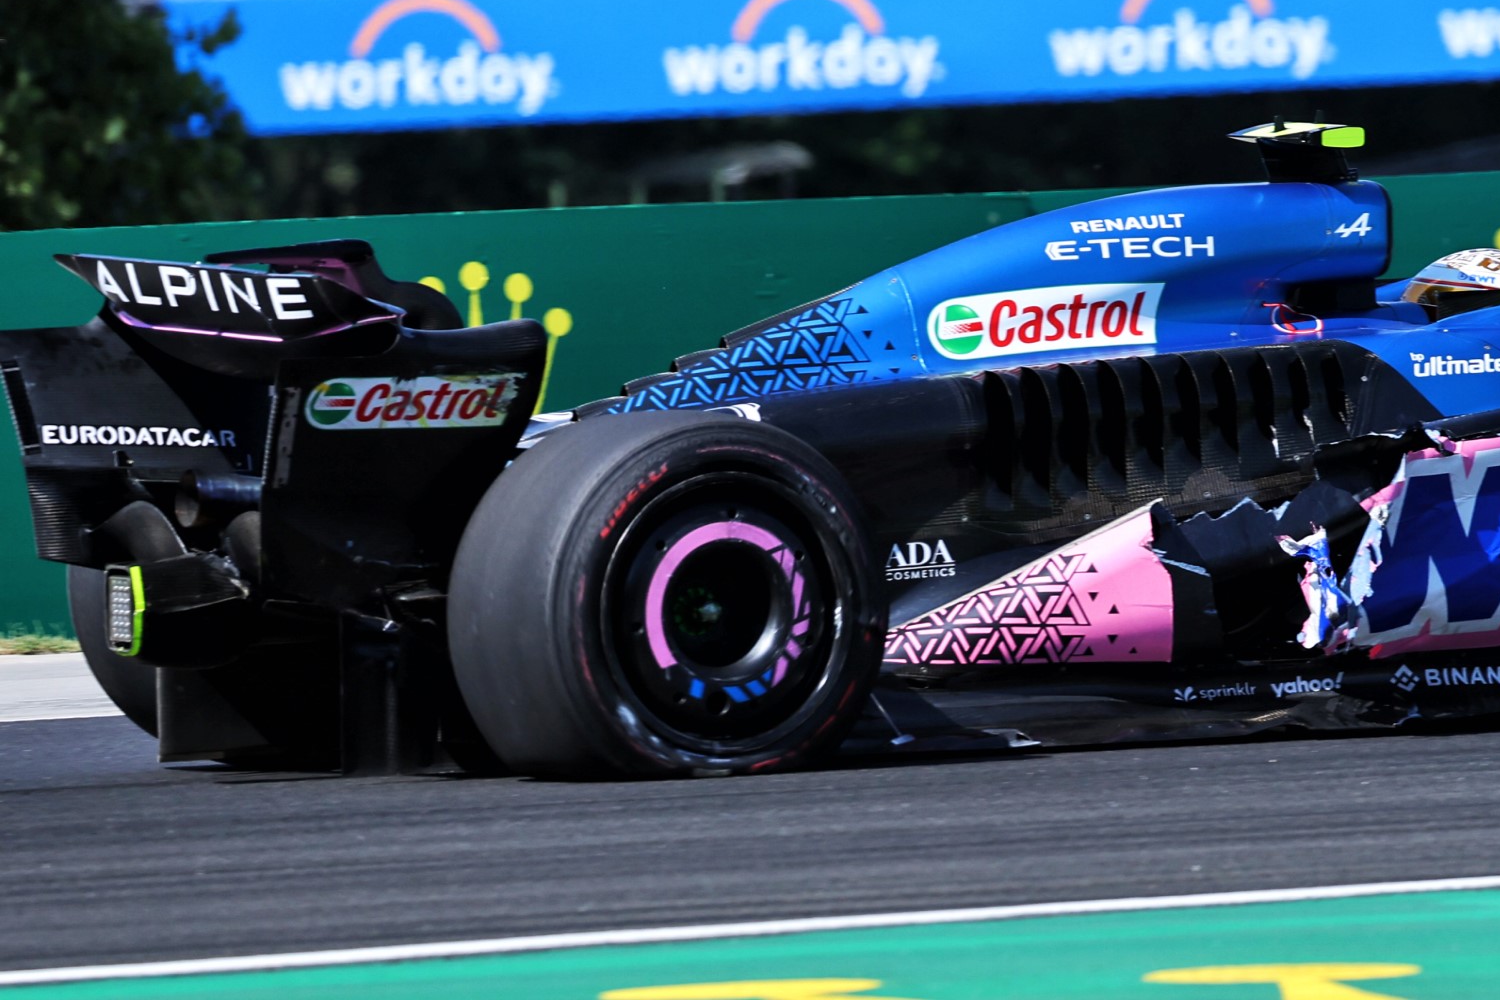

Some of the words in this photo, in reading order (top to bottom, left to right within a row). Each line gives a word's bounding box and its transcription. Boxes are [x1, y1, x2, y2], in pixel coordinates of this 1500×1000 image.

[1048, 4, 1330, 79] workday
[663, 22, 940, 98] workday
[279, 41, 554, 115] workday
[1070, 213, 1185, 234] RENAULT
[1044, 235, 1215, 261] E-TECH
[96, 260, 314, 320] ALPINE
[988, 291, 1146, 349] Castrol
[355, 382, 507, 423] Castrol
[41, 424, 236, 448] EURODATACAR
[885, 538, 956, 568] ADA
[884, 566, 957, 582] COSMETICS
[1199, 683, 1257, 701] sprinklr
[1271, 671, 1345, 699] yahoo!
